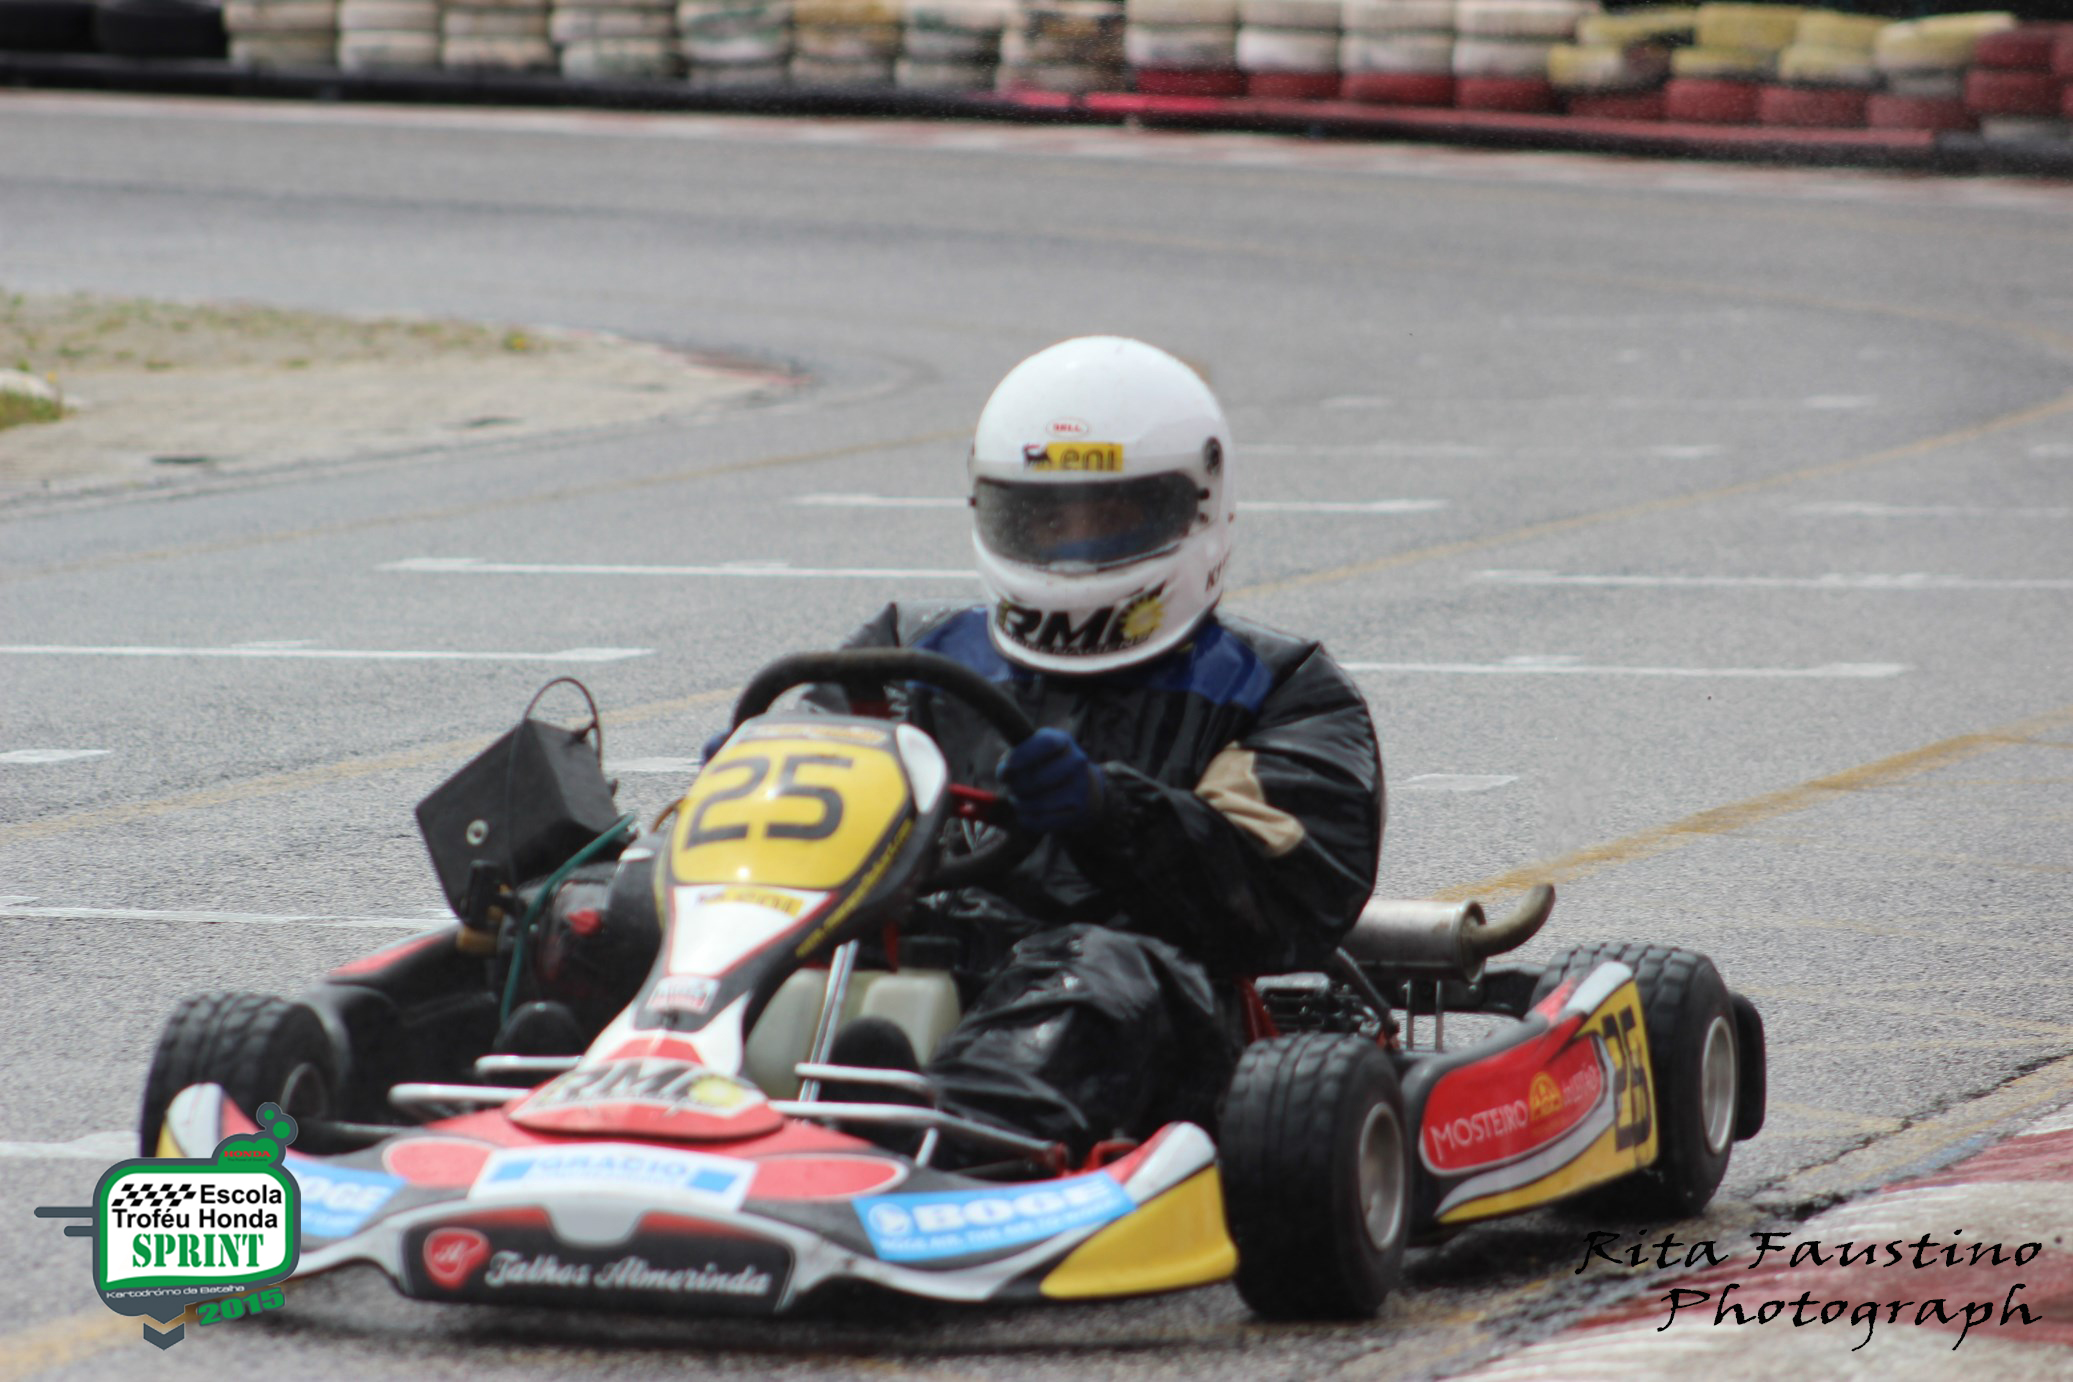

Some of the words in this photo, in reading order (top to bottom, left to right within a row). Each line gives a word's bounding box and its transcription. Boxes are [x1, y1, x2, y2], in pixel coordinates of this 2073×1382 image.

[1060, 444, 1116, 471] eni
[684, 754, 854, 851] 25
[1430, 1099, 1529, 1162] MOSTEIRO
[913, 1181, 1111, 1233] BOGE
[485, 1251, 591, 1287] Talhos
[594, 1256, 773, 1295] Almerinda
